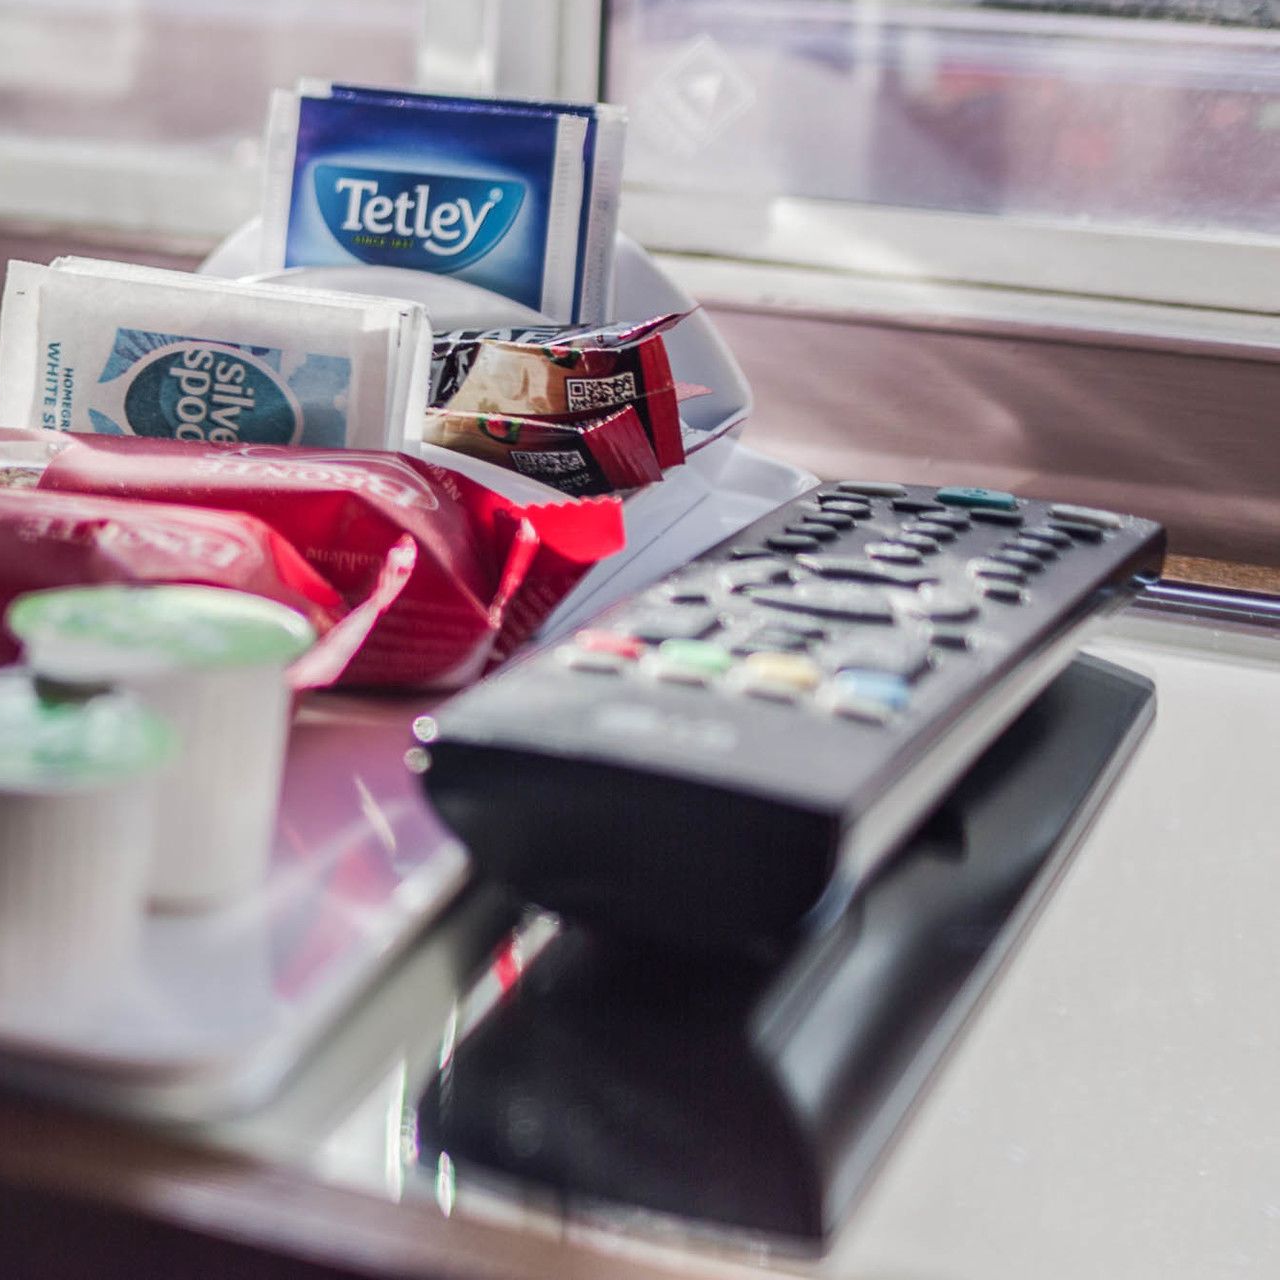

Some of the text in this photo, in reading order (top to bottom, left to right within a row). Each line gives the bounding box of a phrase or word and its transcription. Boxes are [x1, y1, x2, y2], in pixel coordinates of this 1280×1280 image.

[336, 177, 503, 256] Tetley
[44, 342, 61, 407] WHITE
[59, 368, 74, 432] HOMEGR
